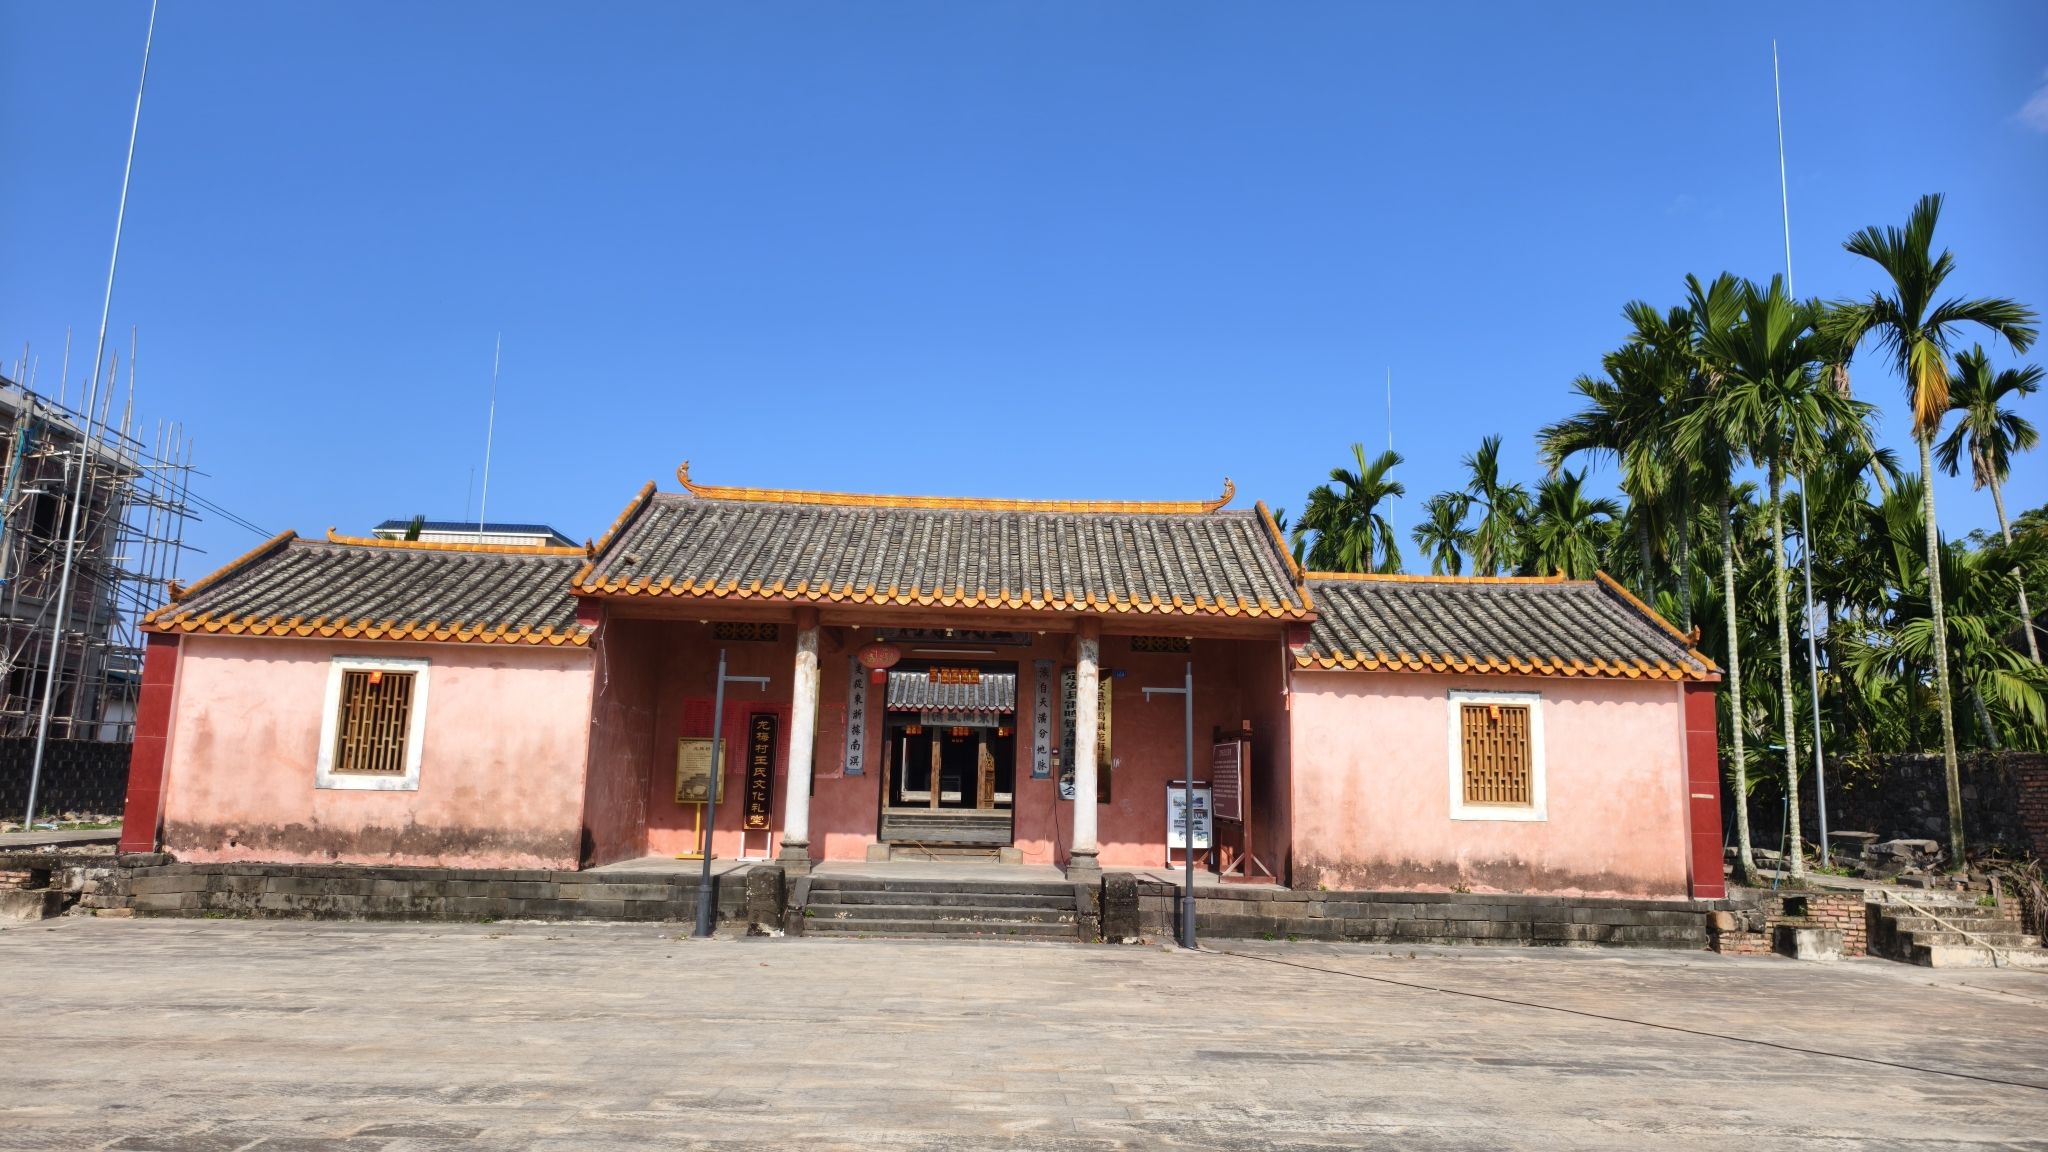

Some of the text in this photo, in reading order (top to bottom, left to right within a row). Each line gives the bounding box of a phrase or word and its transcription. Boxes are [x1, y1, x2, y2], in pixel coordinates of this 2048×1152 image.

[749, 720, 771, 825] 龙梅村王氏文化礼堂
